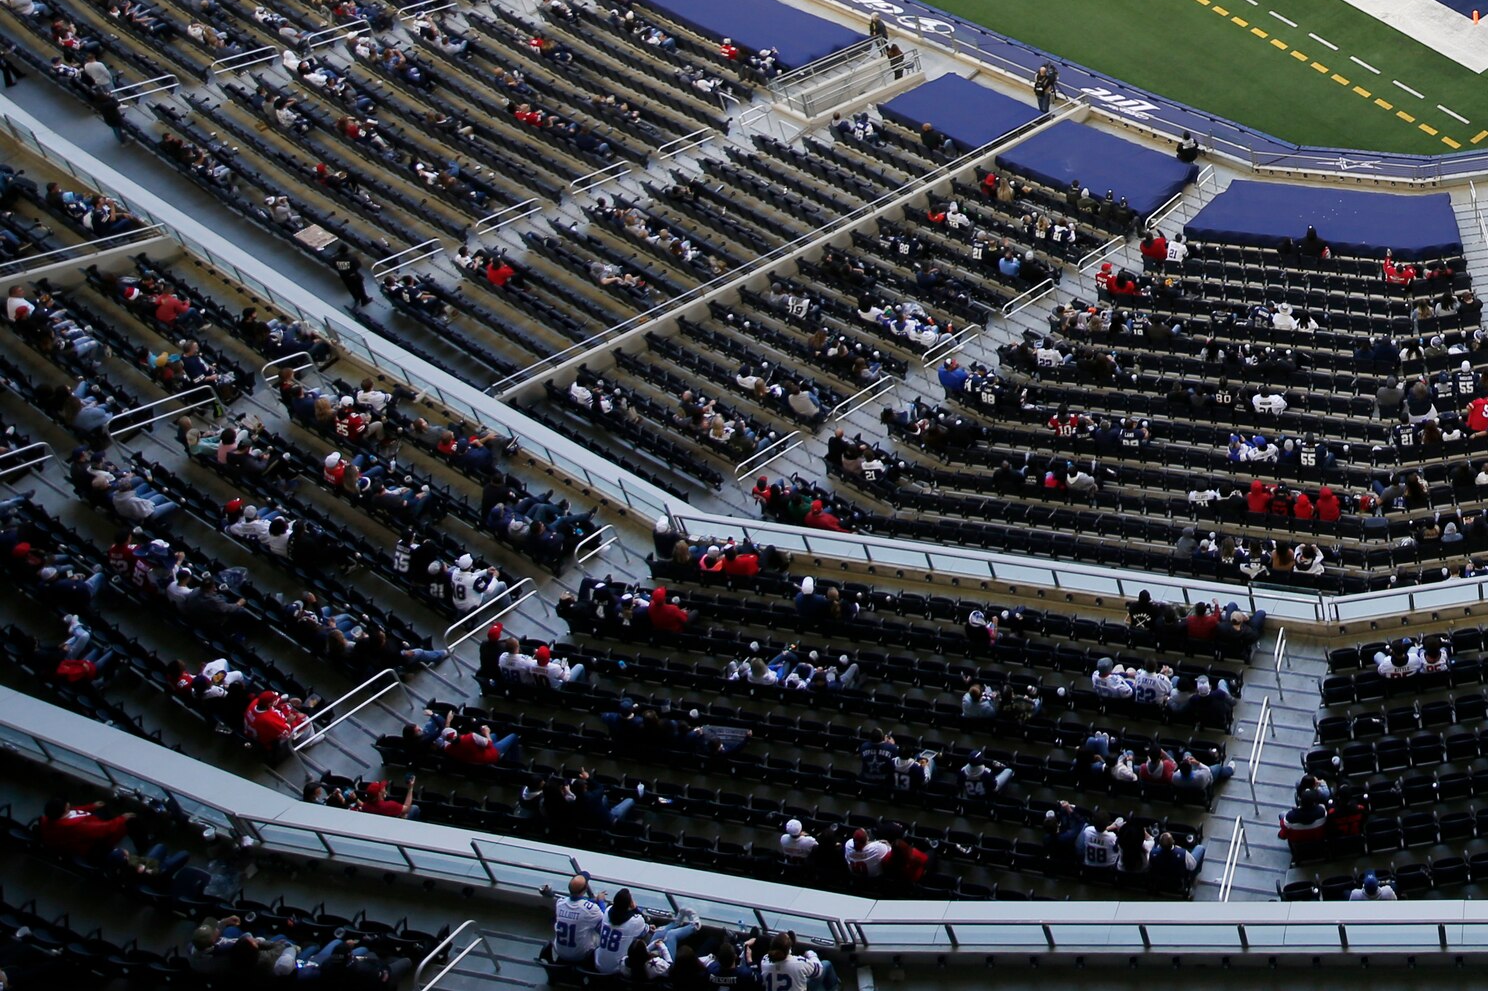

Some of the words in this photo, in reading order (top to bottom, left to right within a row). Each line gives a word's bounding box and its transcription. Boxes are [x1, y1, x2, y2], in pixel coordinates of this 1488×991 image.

[899, 242, 910, 255] 88
[972, 247, 983, 260] 21
[1167, 249, 1178, 259] 21
[1460, 381, 1473, 394] 55
[980, 392, 995, 405] 88
[1215, 394, 1231, 404] 80
[336, 420, 350, 437] 25
[1057, 424, 1072, 436] 10
[1400, 433, 1413, 446] 21
[1300, 453, 1316, 466] 55
[865, 469, 875, 481] 21
[429, 583, 444, 599] 21
[1136, 686, 1156, 703] 22
[893, 773, 909, 790] 13
[966, 780, 983, 795] 24
[1087, 846, 1108, 862] 88
[559, 912, 580, 921] ELLIOTT
[556, 922, 577, 948] 21
[600, 926, 622, 952] 88
[710, 975, 737, 985] PRESCOTT
[765, 973, 792, 991] 12
